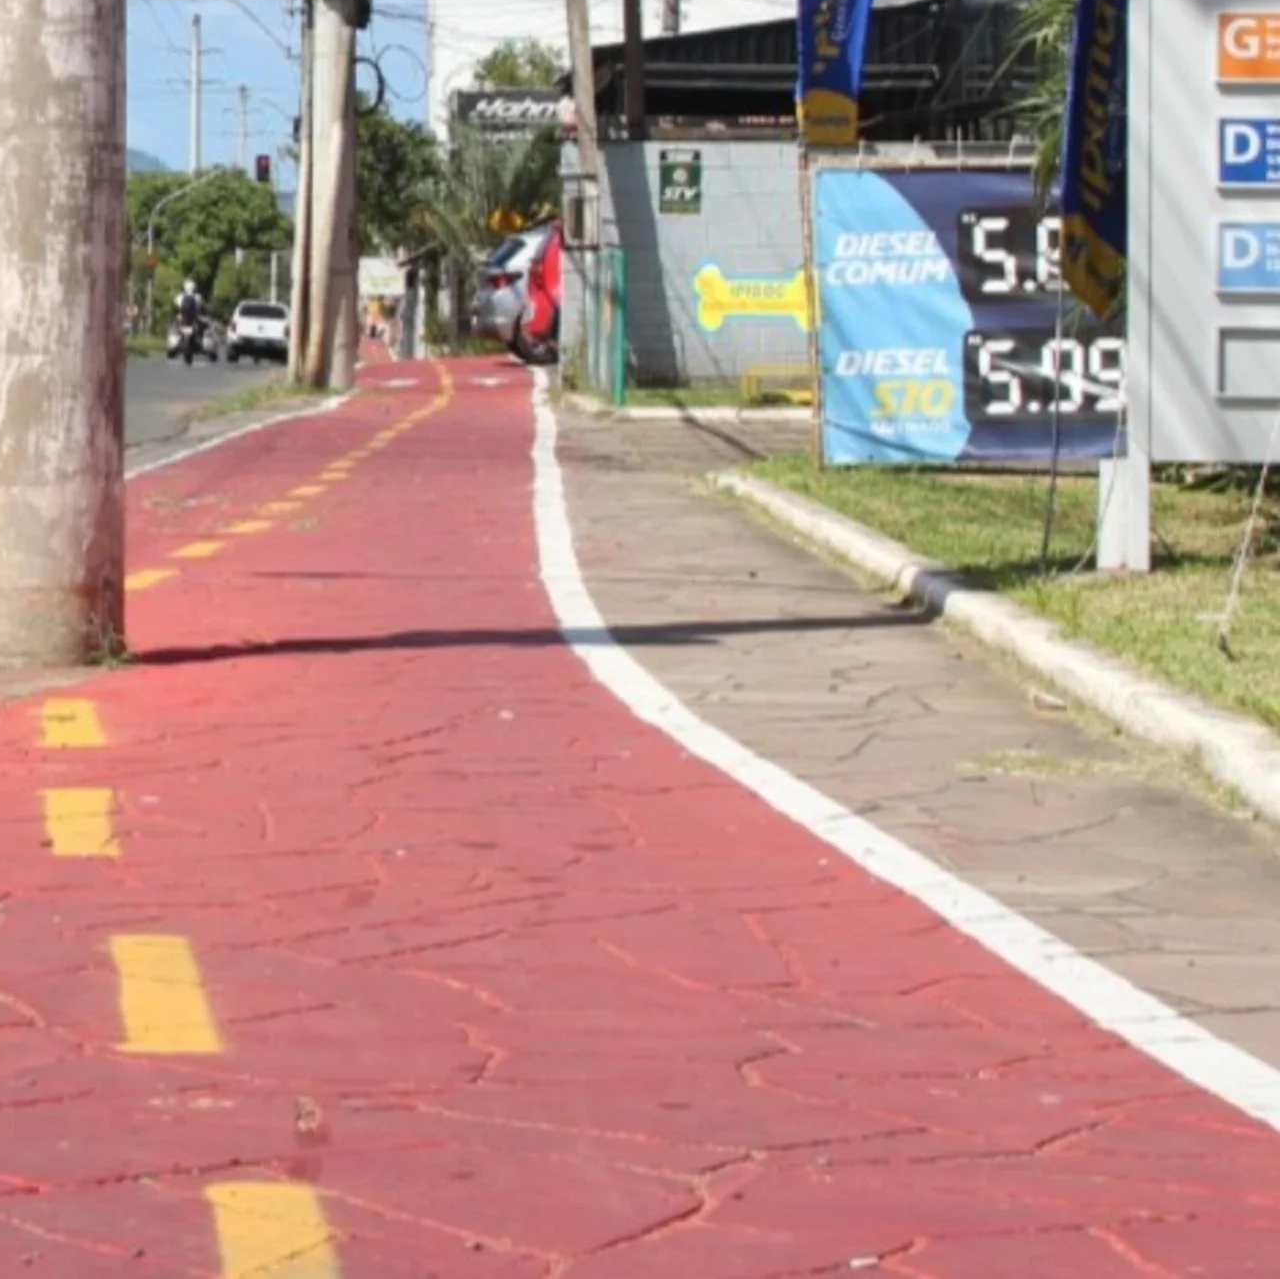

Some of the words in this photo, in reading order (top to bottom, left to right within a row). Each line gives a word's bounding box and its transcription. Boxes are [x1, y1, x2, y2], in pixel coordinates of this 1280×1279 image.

[1222, 17, 1261, 59] G
[1224, 123, 1261, 164] D
[834, 230, 942, 257] DIESEL
[1223, 229, 1260, 270] D
[826, 257, 952, 285] COMUM
[836, 347, 949, 377] DIESEL
[979, 338, 1128, 415] 5.99
[871, 379, 955, 418] S10
